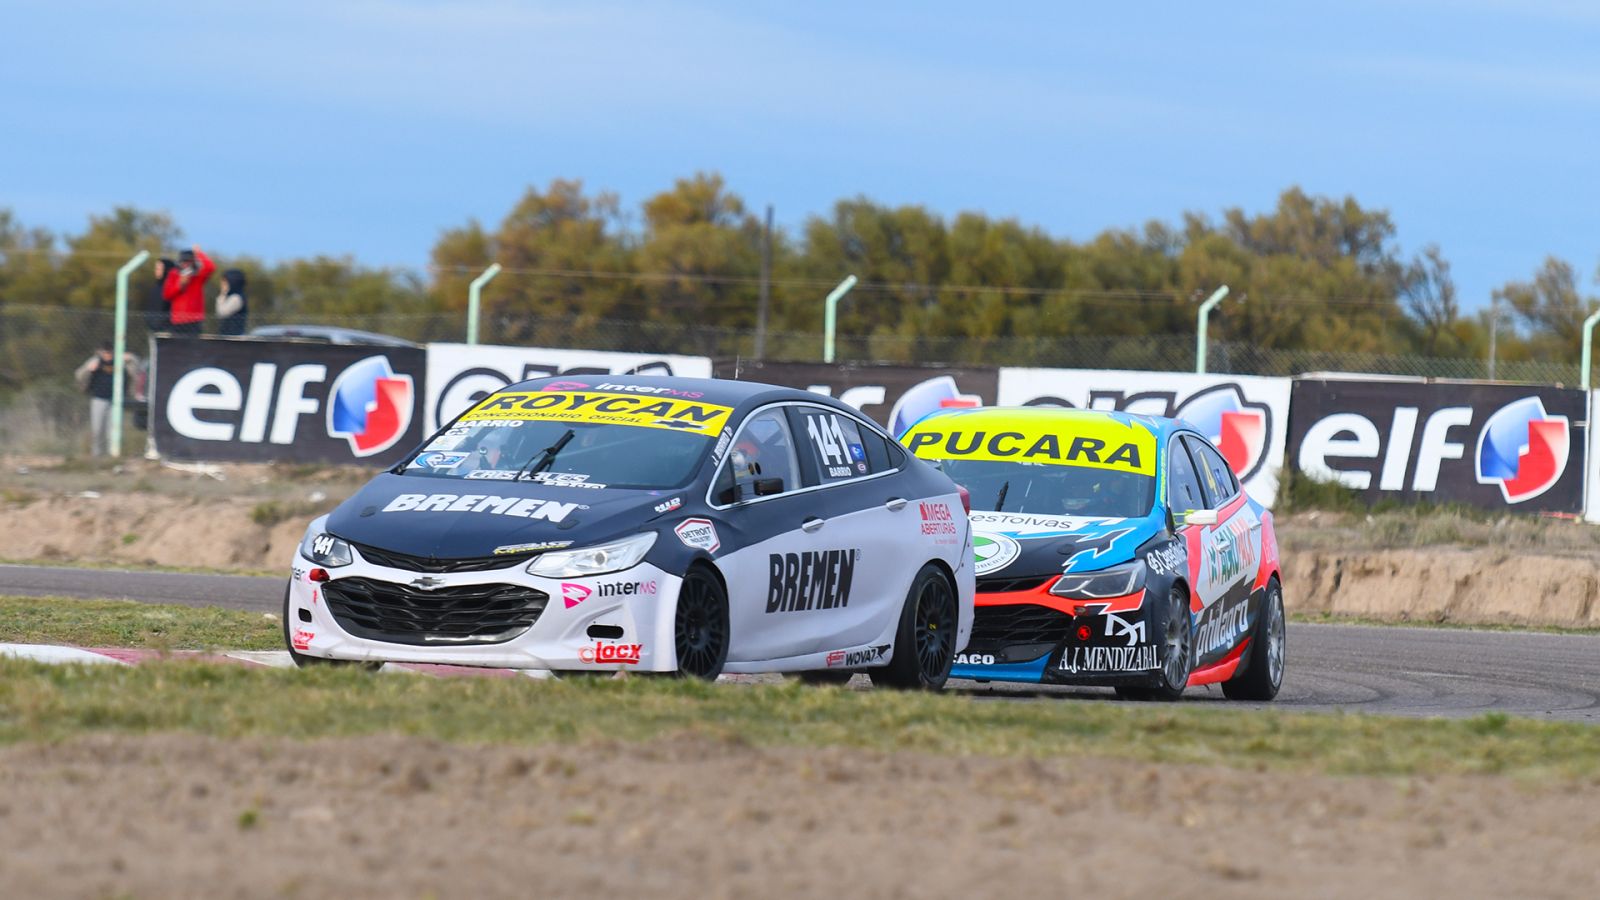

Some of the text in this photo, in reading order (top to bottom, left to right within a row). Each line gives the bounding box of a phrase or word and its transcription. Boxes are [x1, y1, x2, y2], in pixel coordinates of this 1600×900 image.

[166, 363, 327, 444] elf
[480, 395, 725, 422] ROYCAN
[453, 420, 523, 428] BARRIO
[589, 415, 642, 423] OFICIAL
[807, 415, 853, 466] 141
[907, 432, 1141, 468] PUCARA
[1299, 407, 1473, 491] elf
[382, 494, 579, 523] BREMEN
[926, 503, 952, 520] MEGA
[968, 514, 1073, 529] esTolvas
[681, 526, 711, 539] DETROIT
[921, 522, 956, 535] ABERTURAS
[314, 536, 335, 556] 141
[765, 549, 855, 613] BREMEN
[1196, 598, 1249, 666] philagro
[1082, 645, 1162, 671] MENDIZABAL
